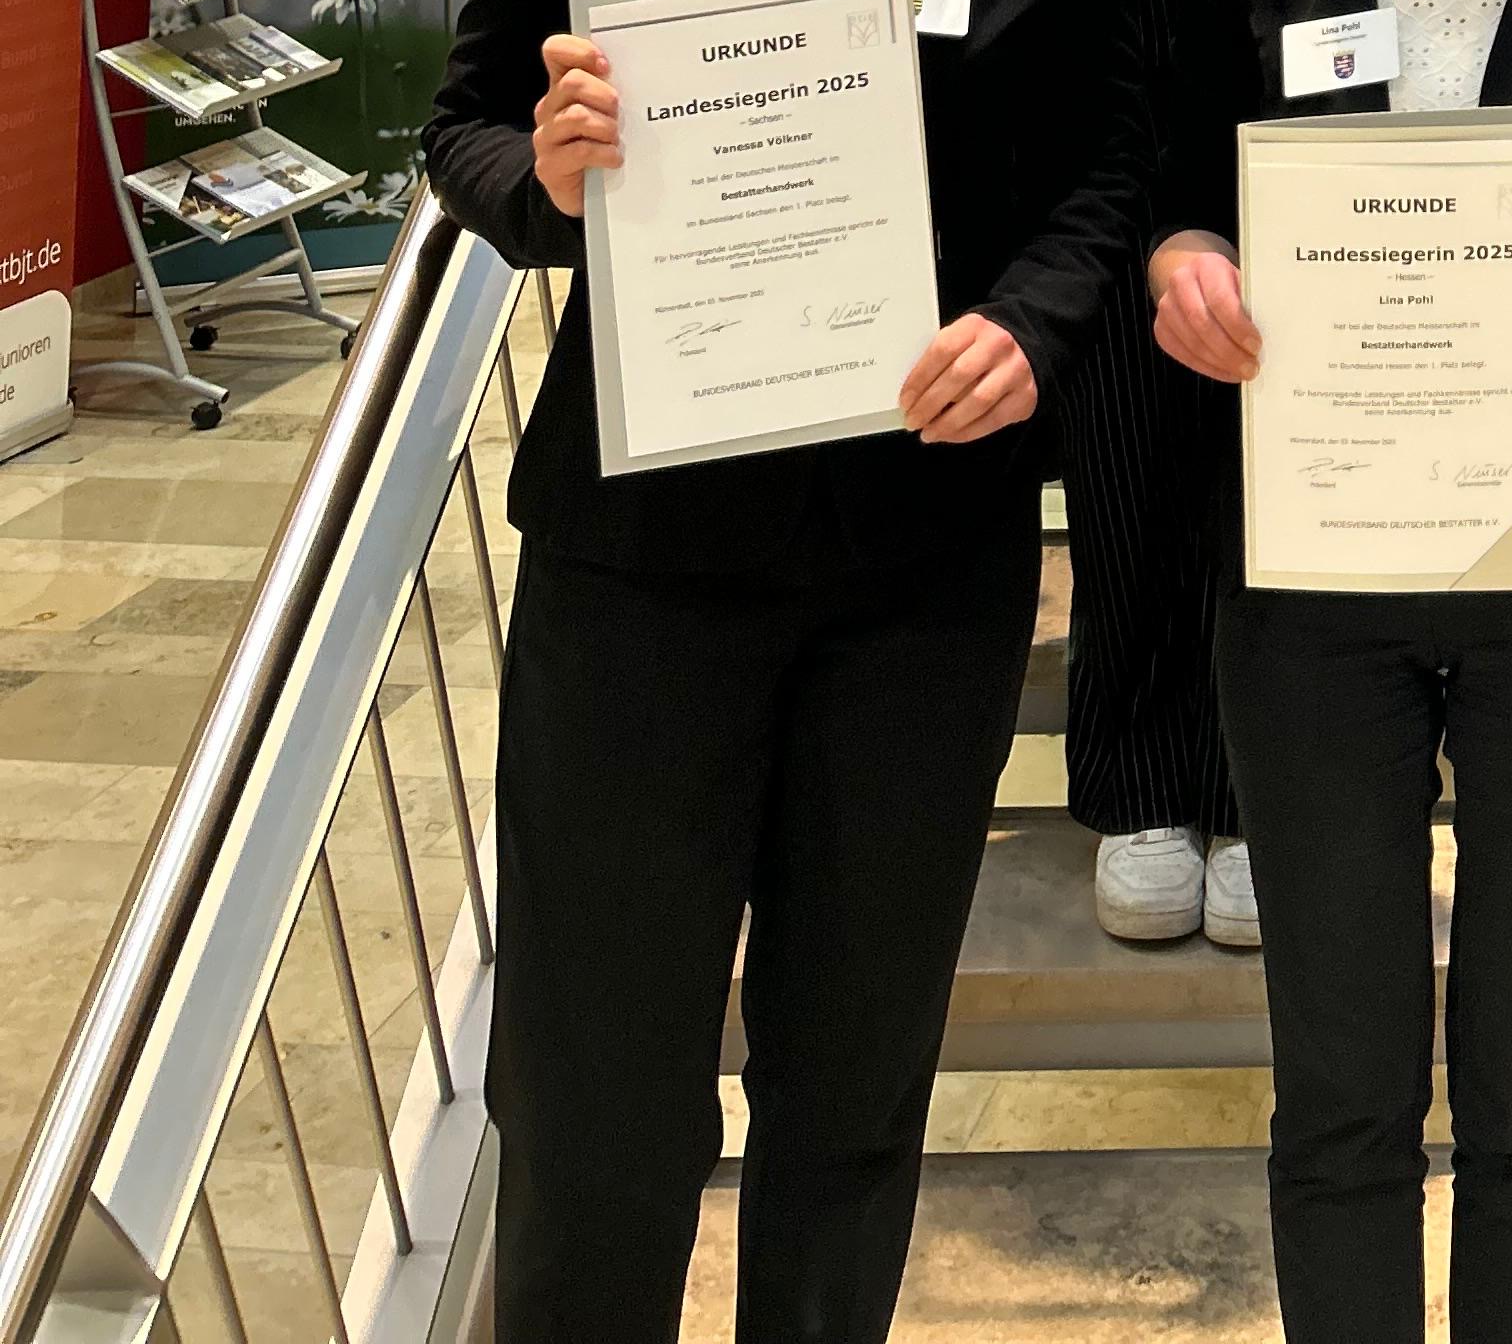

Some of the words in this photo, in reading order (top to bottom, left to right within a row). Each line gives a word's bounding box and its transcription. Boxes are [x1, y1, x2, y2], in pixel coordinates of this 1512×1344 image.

[1321, 25, 1340, 36] Lina
[1341, 21, 1361, 33] Pohl
[701, 32, 806, 62] URKUNDE
[647, 83, 808, 121] Landessiegerin
[817, 71, 868, 93] 2025
[713, 140, 763, 155] Vanessa
[766, 132, 812, 146] Völkner
[720, 177, 814, 200] Bestatterhandwerk
[1353, 197, 1456, 213] URKUNDE
[0, 238, 61, 285] tbjt.de
[1296, 245, 1454, 265] Landessiegerin
[1395, 272, 1426, 281] Hessen
[1379, 295, 1403, 304] Lina
[1407, 294, 1433, 304] Pohl
[1361, 339, 1452, 349] Bestatterhandwerk
[692, 378, 763, 398] BUNDESVERBAND
[764, 369, 812, 385] DEUTSCHER
[814, 361, 860, 376] BESTATTER
[1319, 520, 1388, 528] BUNDESVERBAND
[1389, 520, 1436, 528] DEUTSCHER
[1438, 518, 1482, 528] BESTATTER
